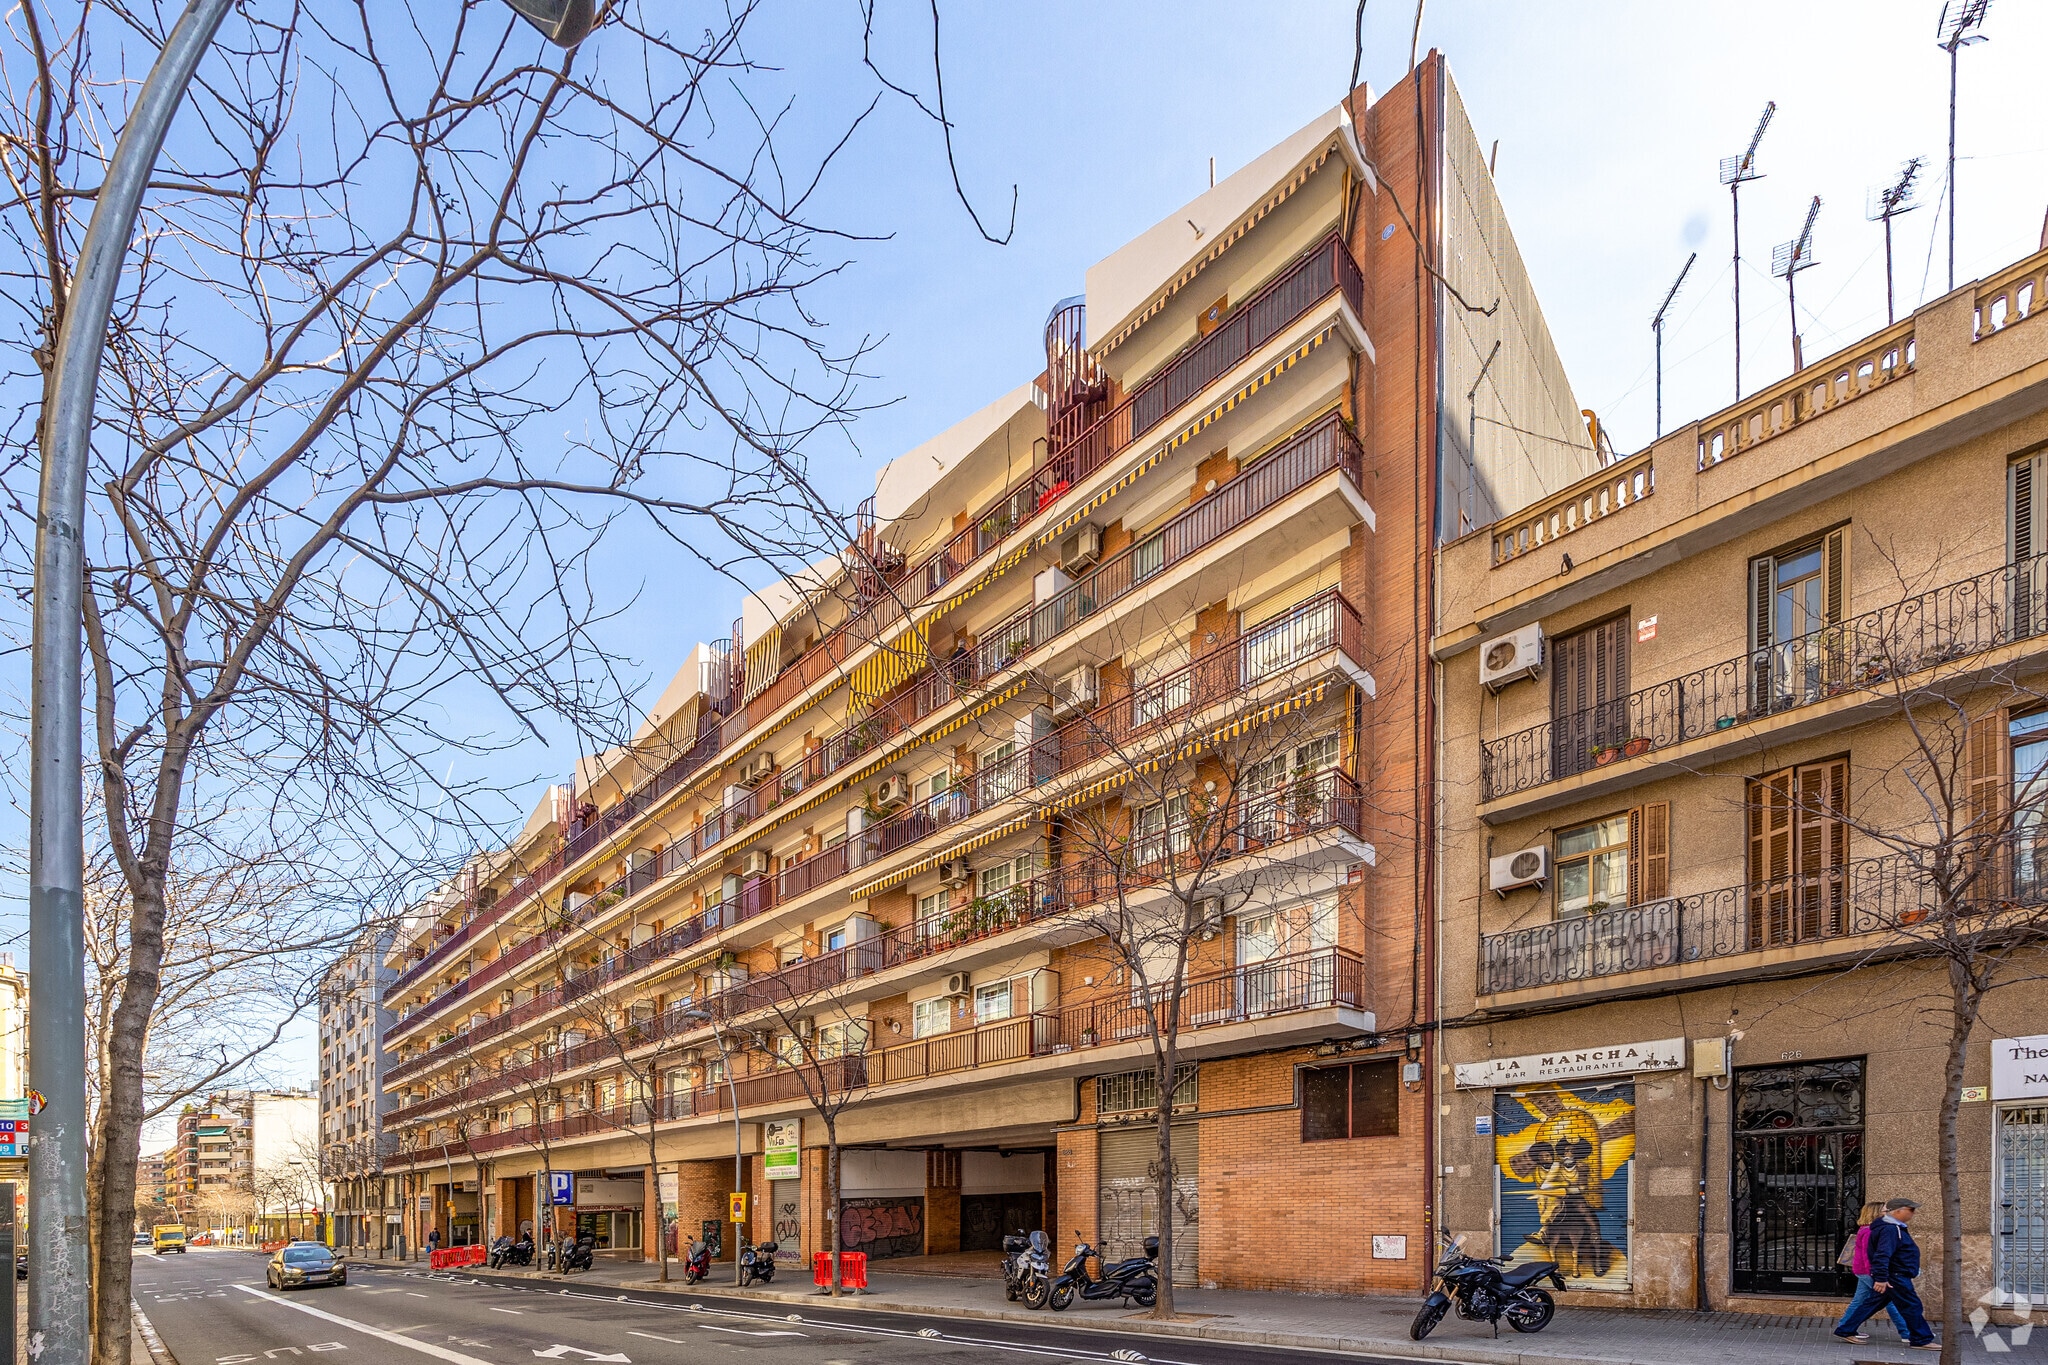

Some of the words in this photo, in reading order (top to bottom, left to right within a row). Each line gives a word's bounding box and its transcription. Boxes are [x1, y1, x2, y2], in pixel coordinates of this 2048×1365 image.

[1496, 1061, 1520, 1071] LA
[1541, 1048, 1639, 1066] MANCHA
[1781, 1050, 1802, 1060] 626
[1505, 1071, 1526, 1079] BAR
[1539, 1061, 1624, 1075] RESTAURANTE
[551, 1173, 568, 1197] P
[215, 1341, 349, 1365] BUS
